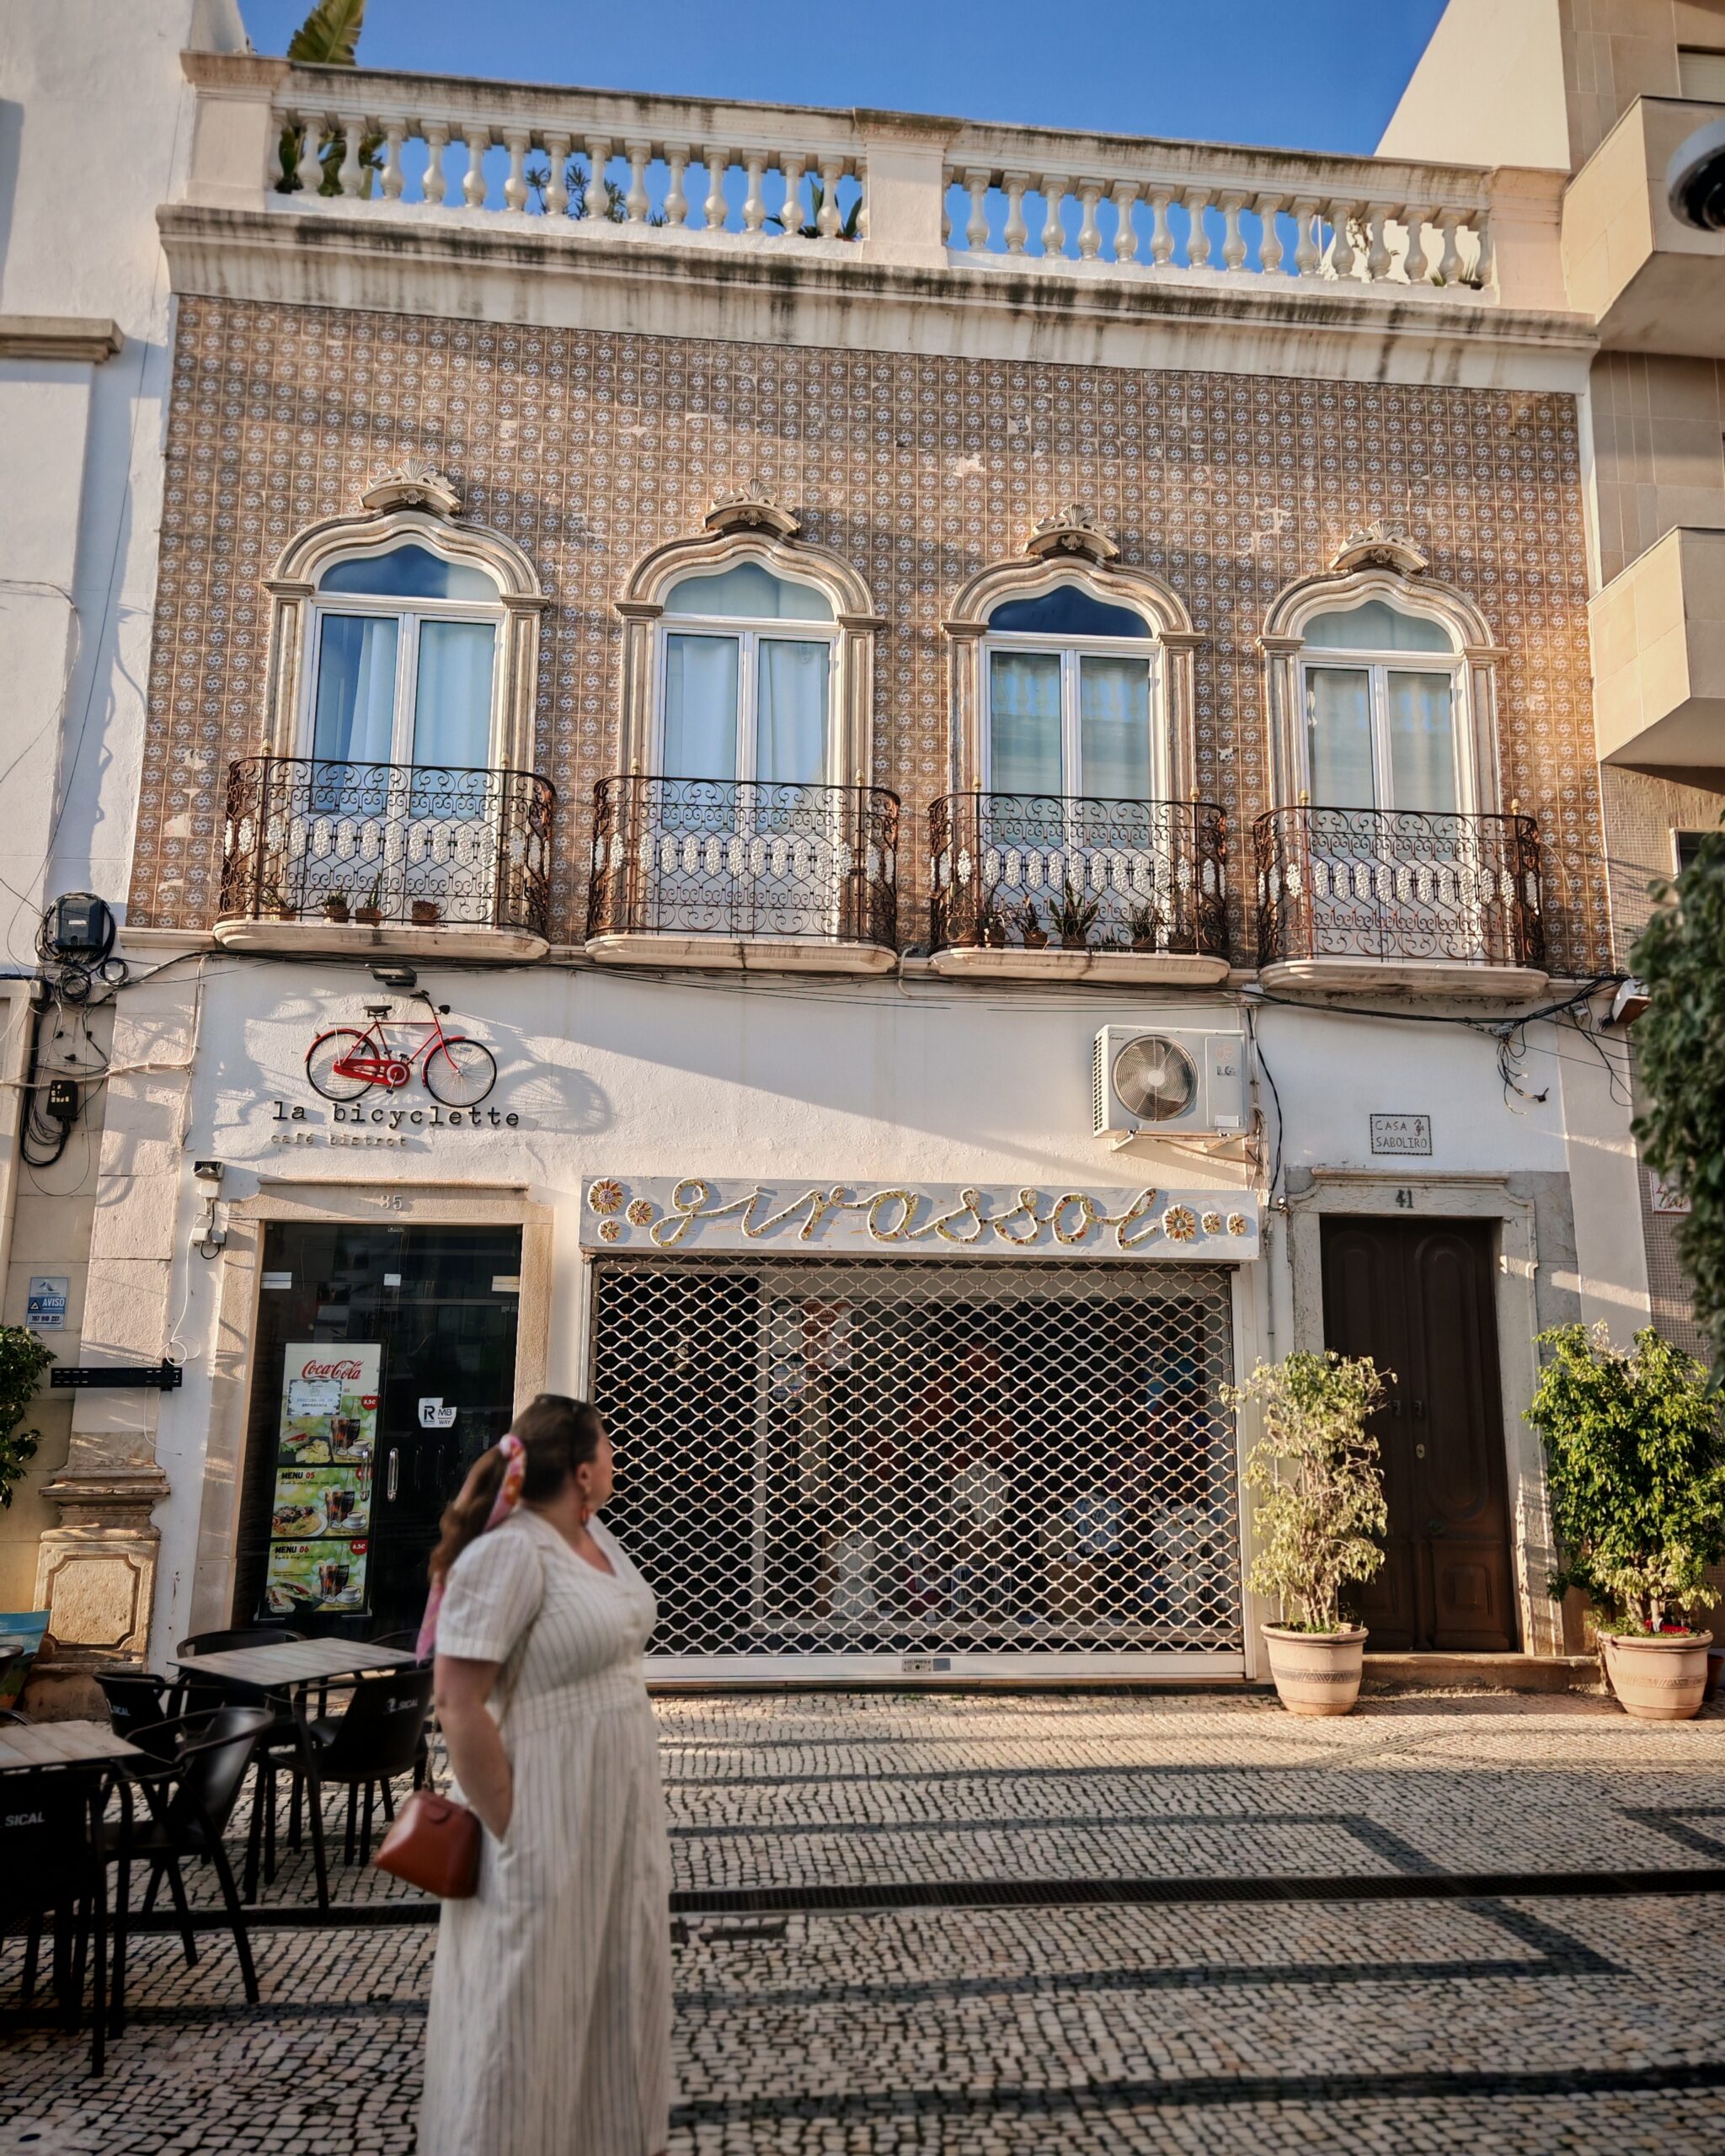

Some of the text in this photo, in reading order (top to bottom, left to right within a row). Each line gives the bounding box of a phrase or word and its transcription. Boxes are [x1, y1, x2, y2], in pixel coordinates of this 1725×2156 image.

[1216, 1065, 1234, 1076] LG
[272, 1101, 519, 1129] la bicyclette
[1375, 1120, 1407, 1132] CASA
[270, 1133, 407, 1147] café bistrot
[1375, 1136, 1428, 1150] SABOLIRO
[380, 1194, 403, 1210] 35
[1395, 1188, 1414, 1209] 41
[649, 1177, 1159, 1250] girassol
[42, 1298, 65, 1307] AVISO
[301, 1359, 365, 1380] Coca-Cola
[438, 1408, 452, 1417] MB
[281, 1471, 303, 1480] MENU
[275, 1545, 297, 1554] MENU
[4, 1811, 45, 1827] SICAL
